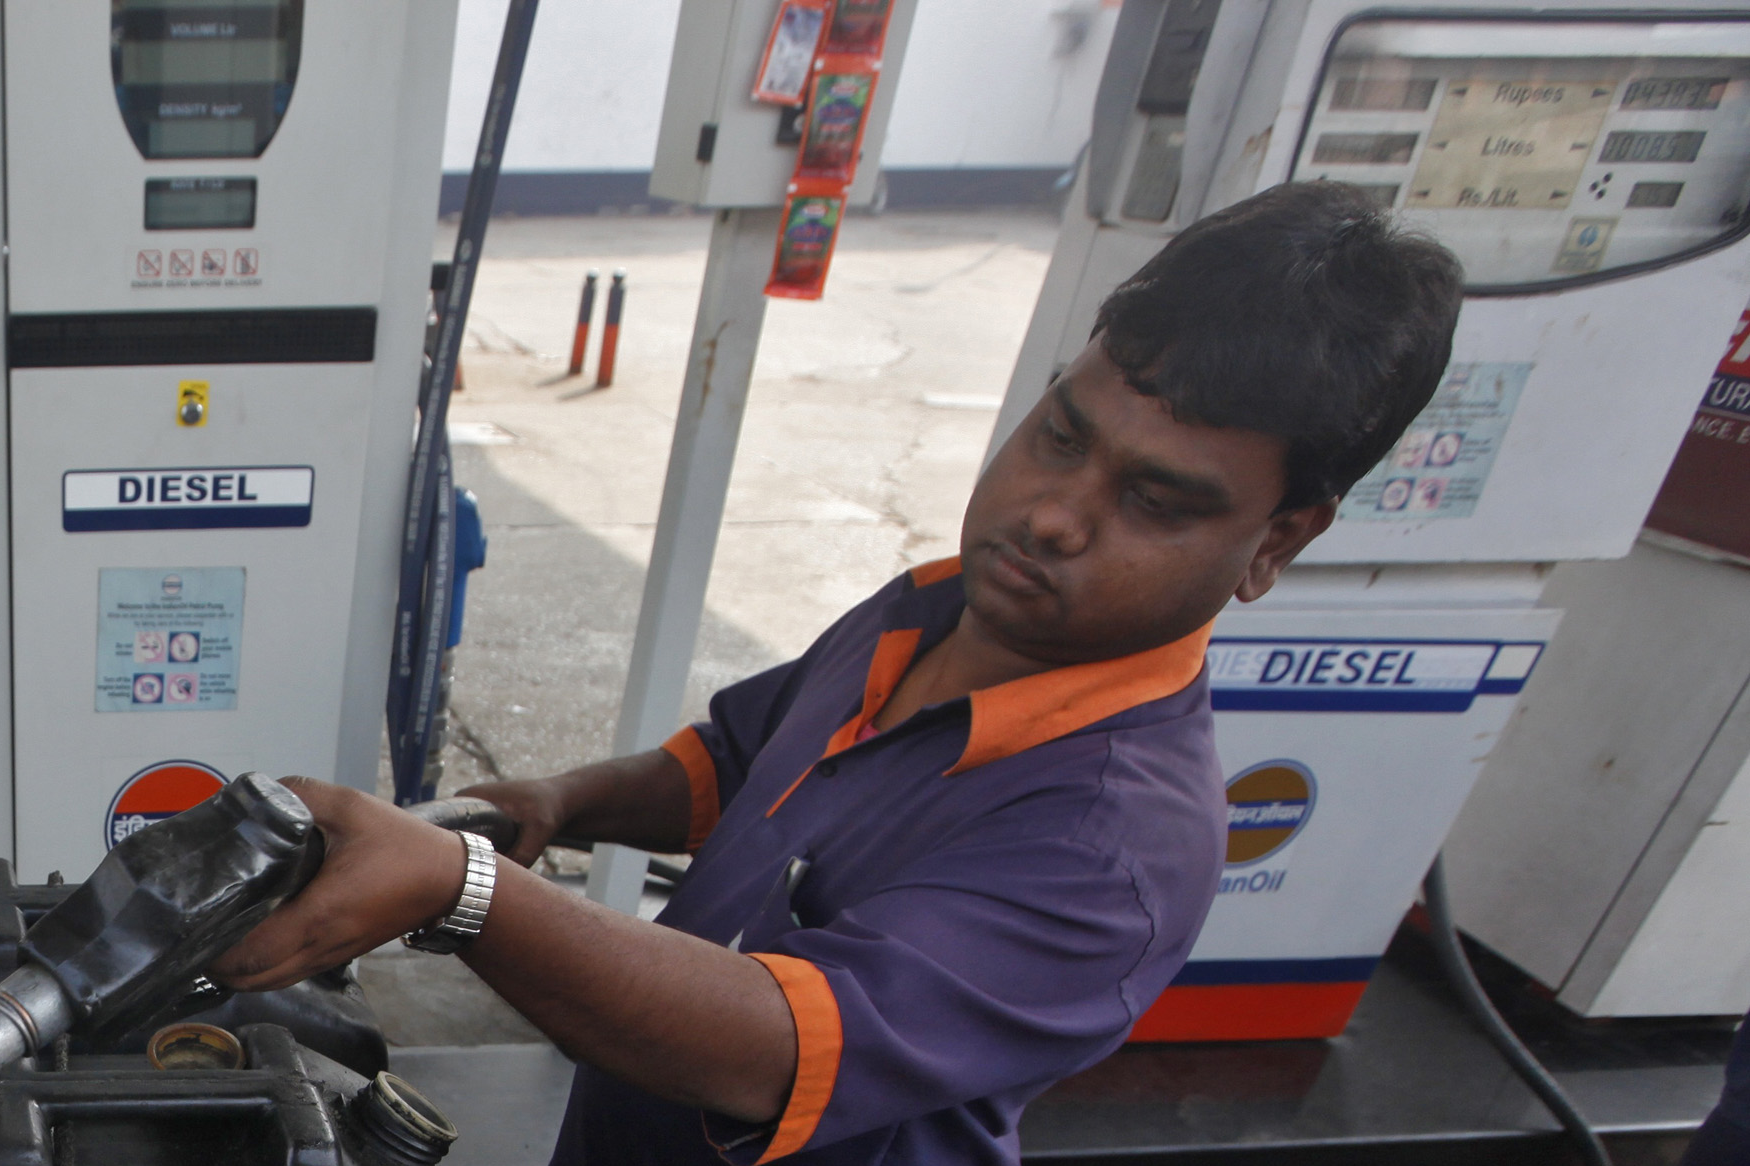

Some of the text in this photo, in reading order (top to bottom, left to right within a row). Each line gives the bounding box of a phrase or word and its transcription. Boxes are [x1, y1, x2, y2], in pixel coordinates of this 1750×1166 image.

[1493, 82, 1567, 106] Rupees
[1479, 136, 1536, 157] Litres
[117, 474, 258, 503] DIESEL
[1258, 650, 1418, 684] DIESEL
